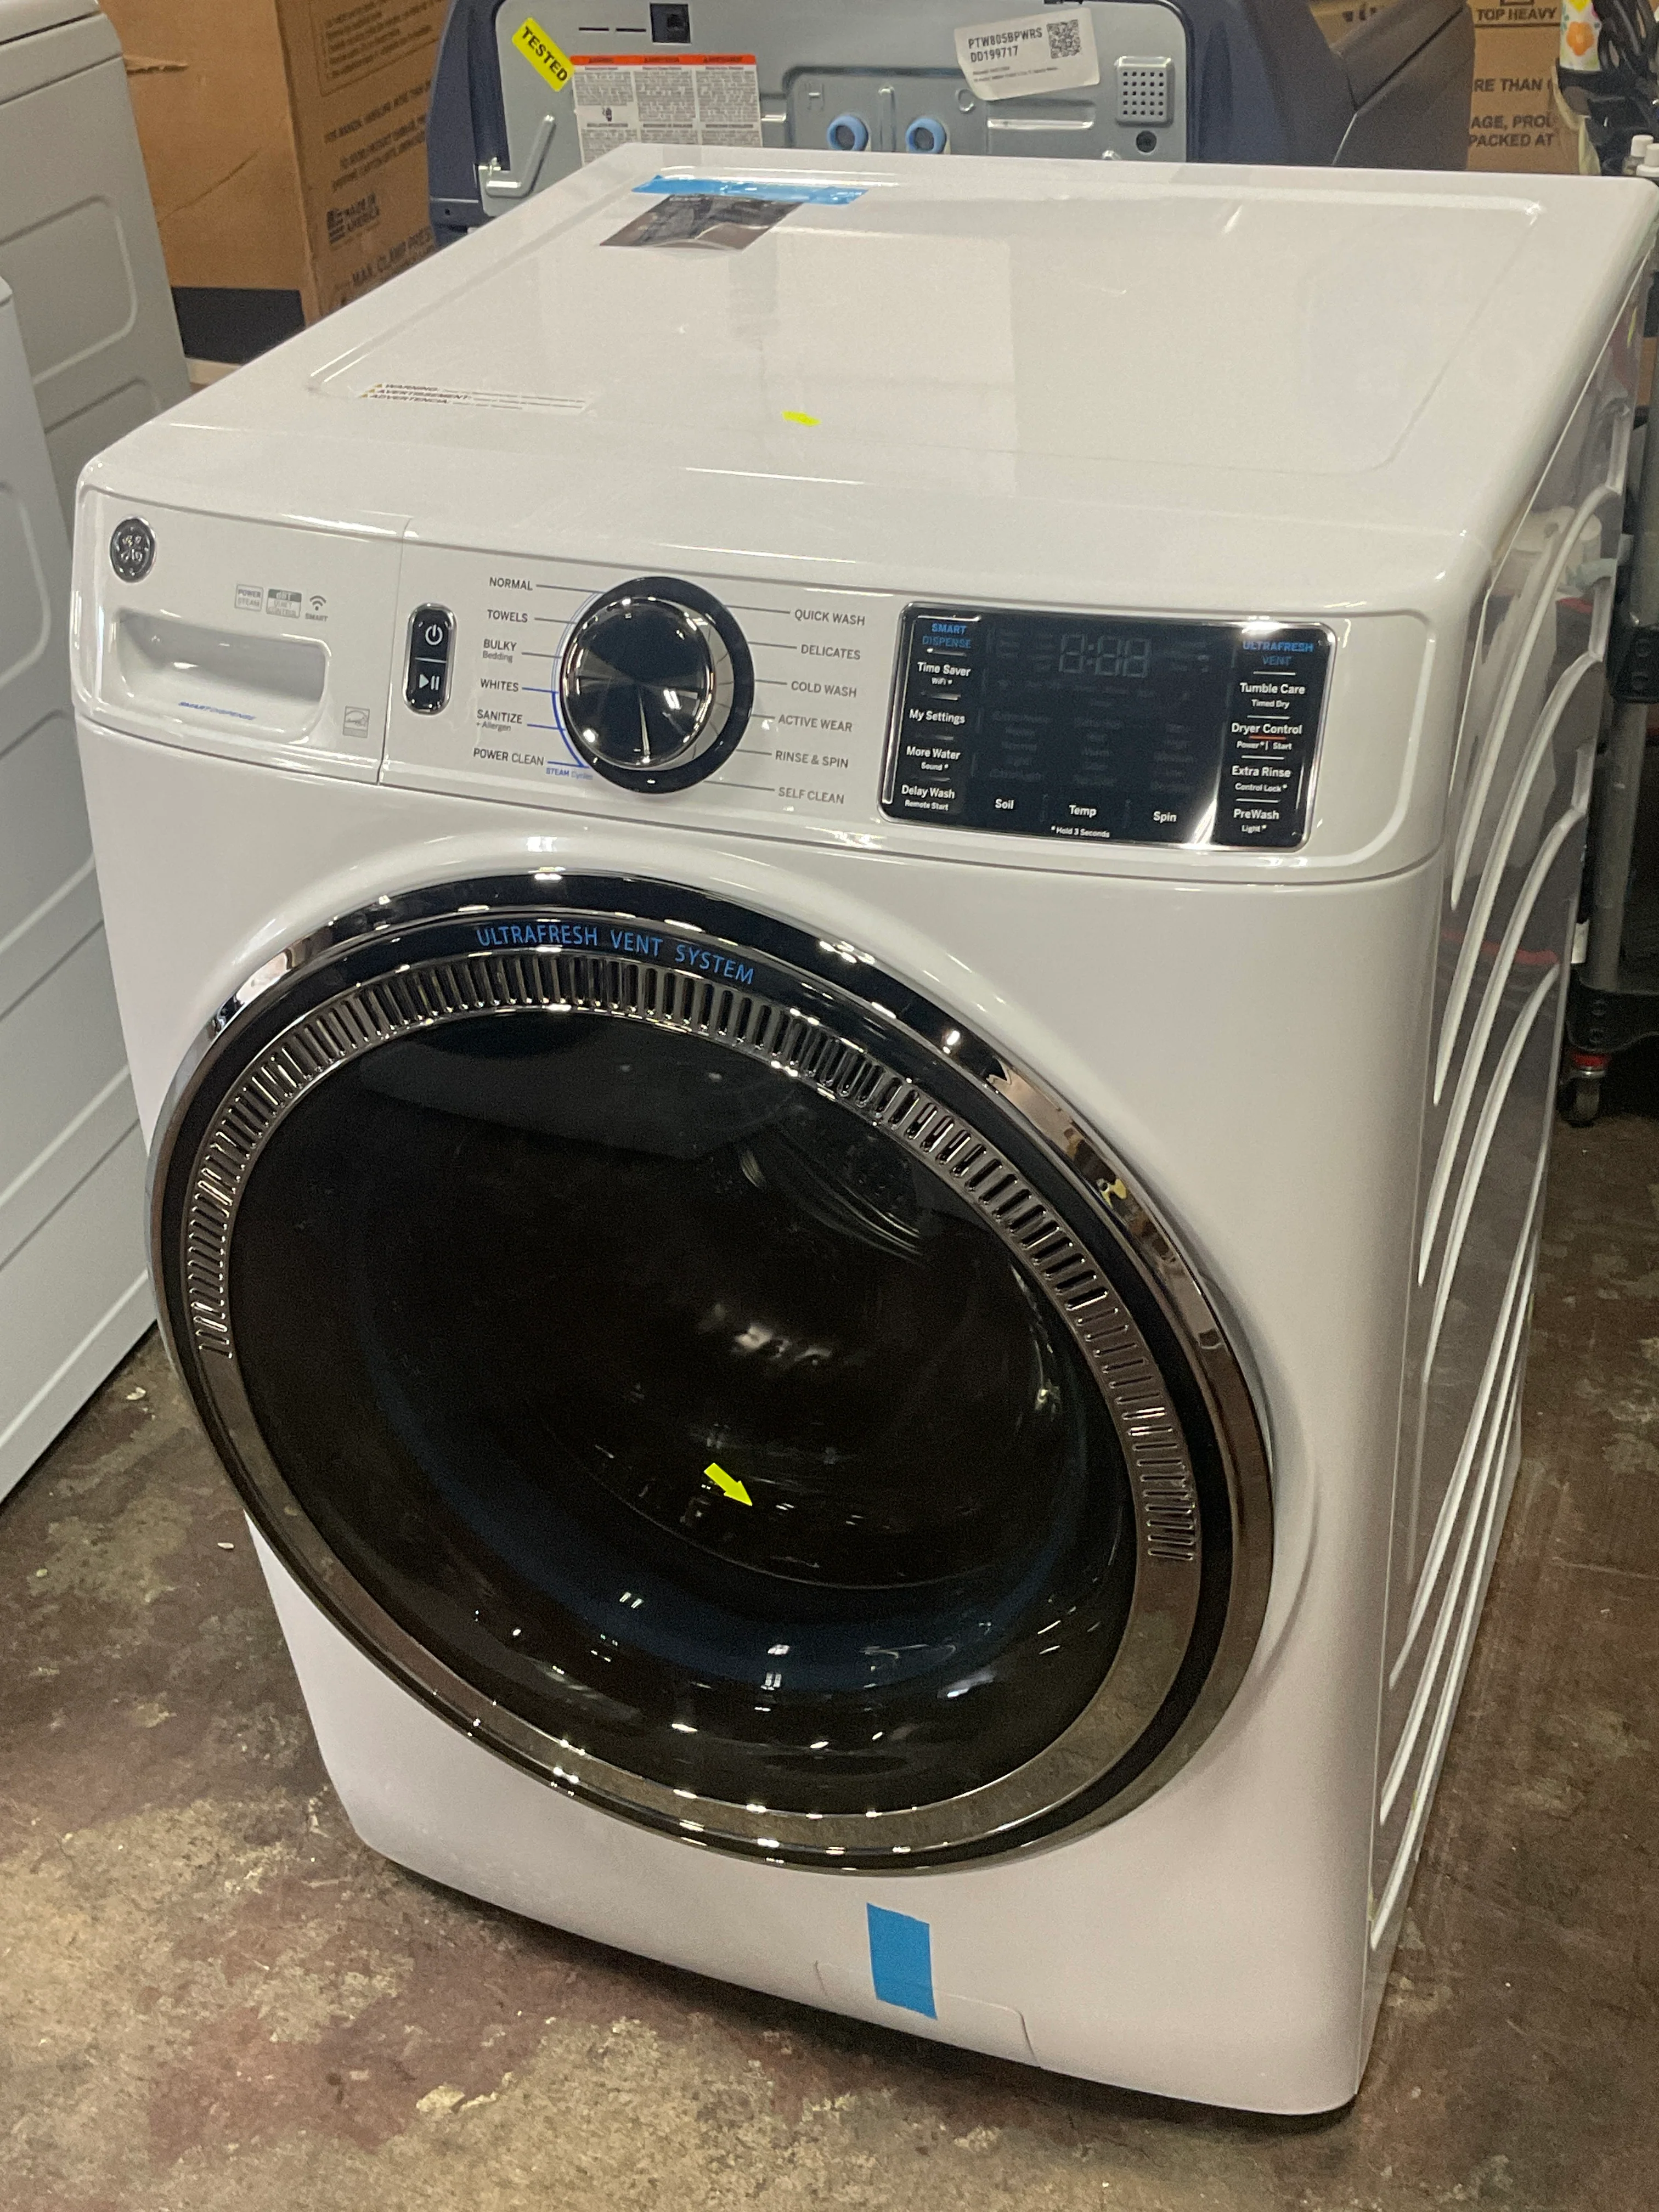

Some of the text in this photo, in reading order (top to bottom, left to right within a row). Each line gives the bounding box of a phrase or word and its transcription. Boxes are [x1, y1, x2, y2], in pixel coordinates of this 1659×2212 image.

[1476, 7, 1557, 21] TOP HEAVY
[522, 26, 567, 81] TESTED
[1499, 77, 1542, 92] THAN
[489, 577, 533, 591] NORMAL
[305, 612, 328, 622] SMART
[488, 609, 528, 623] TOWELS
[794, 609, 865, 626] QUICK WASH
[931, 623, 967, 635] SMART
[483, 638, 517, 652] BULKY
[922, 636, 972, 650] DISPENSE
[1242, 640, 1314, 653] ULTRAFRESH
[483, 651, 514, 663] Bedding
[801, 644, 861, 660] DELICATES
[1262, 655, 1293, 666] VENT
[917, 662, 971, 677] Time Saver
[481, 678, 520, 692] WHITES
[791, 680, 857, 698] COLD WASH
[1239, 682, 1306, 695] Tumble Care
[1251, 698, 1290, 710] Timed Dry
[477, 709, 522, 724] SANITIZE
[778, 714, 853, 732] ACTIVE WEAR
[909, 709, 966, 724] My Settings
[482, 721, 511, 732] Allergen
[1231, 723, 1302, 736] Dryer Control
[906, 746, 960, 760] More Water
[1272, 742, 1293, 750] Start
[473, 748, 544, 766] POWER CLEAN
[775, 750, 849, 769] RINSE & SPIN
[546, 768, 569, 776] STEAM
[1232, 765, 1291, 778] Extra Rinse
[901, 785, 955, 799] Delay Wash
[1235, 783, 1263, 792] Control
[778, 787, 844, 804] SELF CLEAN
[905, 799, 949, 811] Remote Start
[995, 798, 1015, 810] Soil
[1069, 805, 1097, 818] Temp
[1153, 810, 1177, 823] Spin
[1233, 808, 1279, 821] PreWash
[1080, 828, 1110, 838] Seconds
[476, 924, 755, 985] ULTRAFRESH VENT SYSTEM
